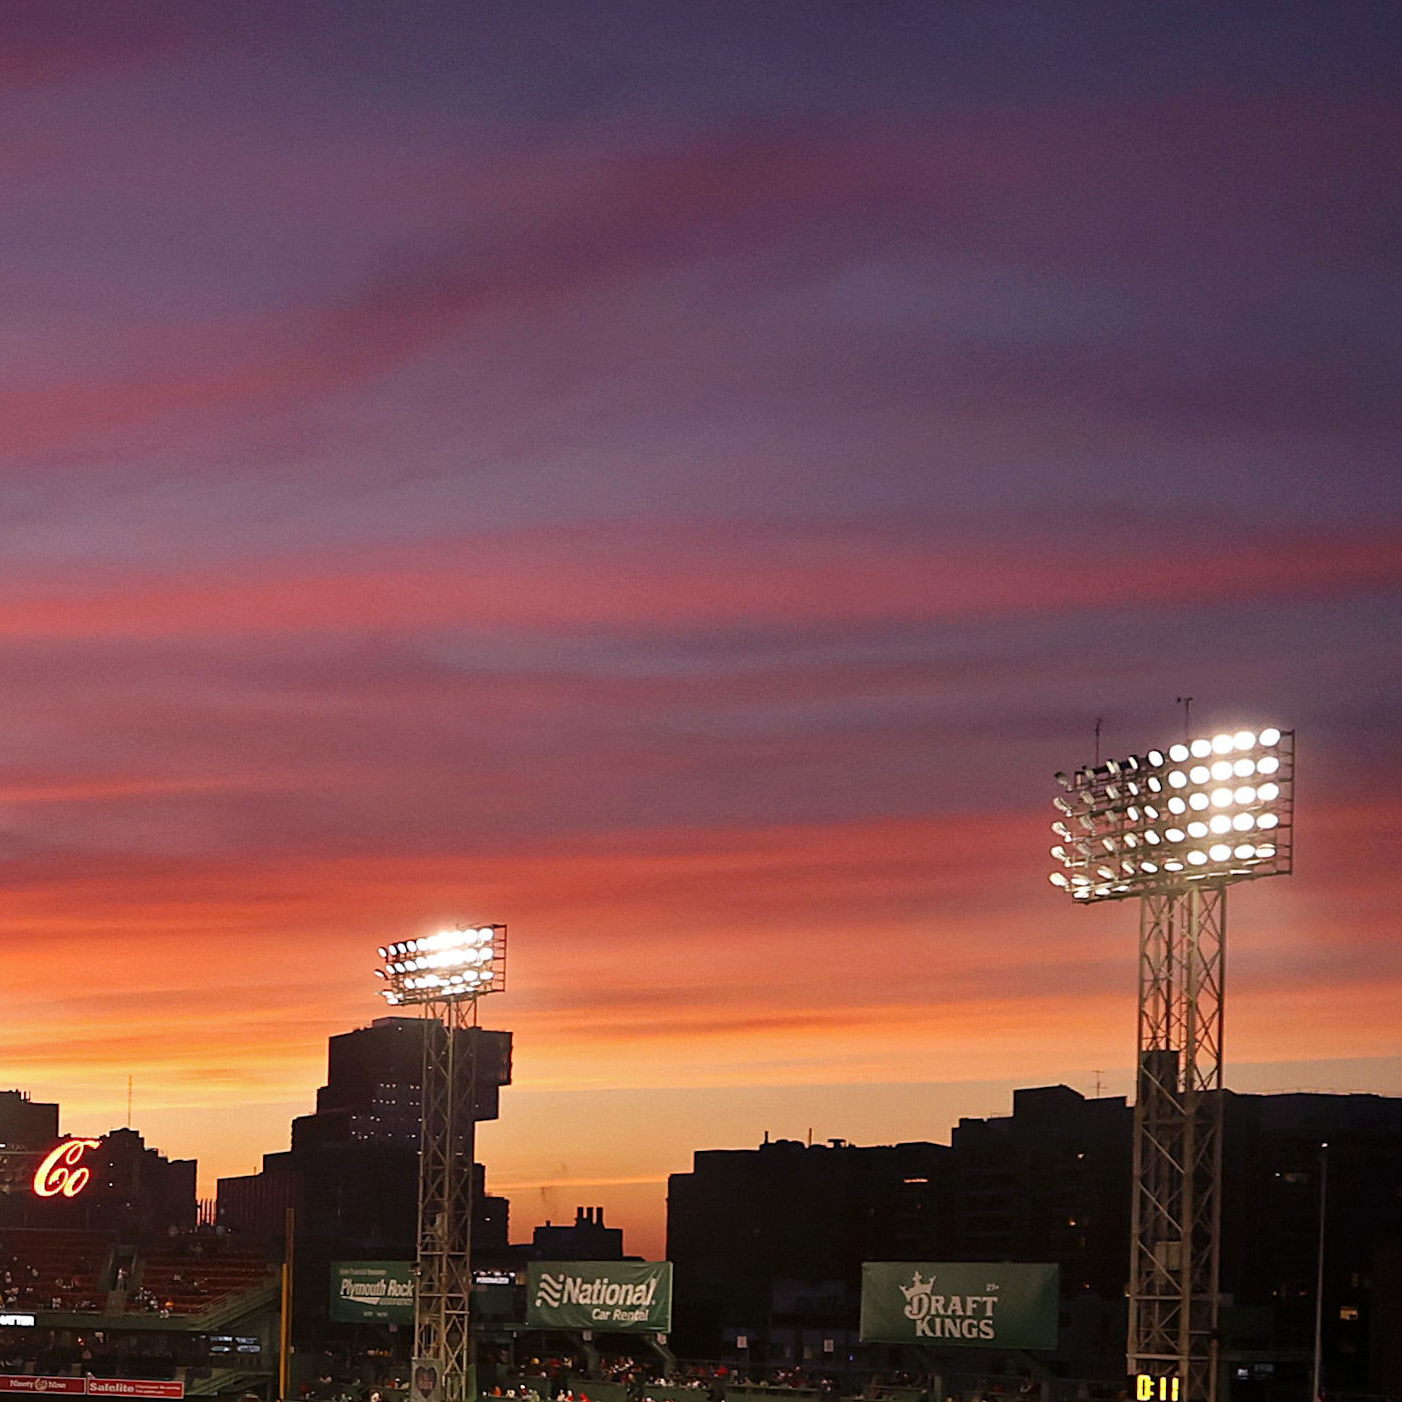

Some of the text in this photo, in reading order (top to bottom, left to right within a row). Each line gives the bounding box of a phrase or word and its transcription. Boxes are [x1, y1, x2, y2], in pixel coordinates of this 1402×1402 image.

[340, 1278, 415, 1299] Plymouth Rock
[561, 1275, 658, 1306] National
[591, 1308, 650, 1322] Car Rental
[903, 1292, 999, 1320] DRAFT
[915, 1315, 996, 1340] KINGS
[89, 1381, 135, 1397] Safelite
